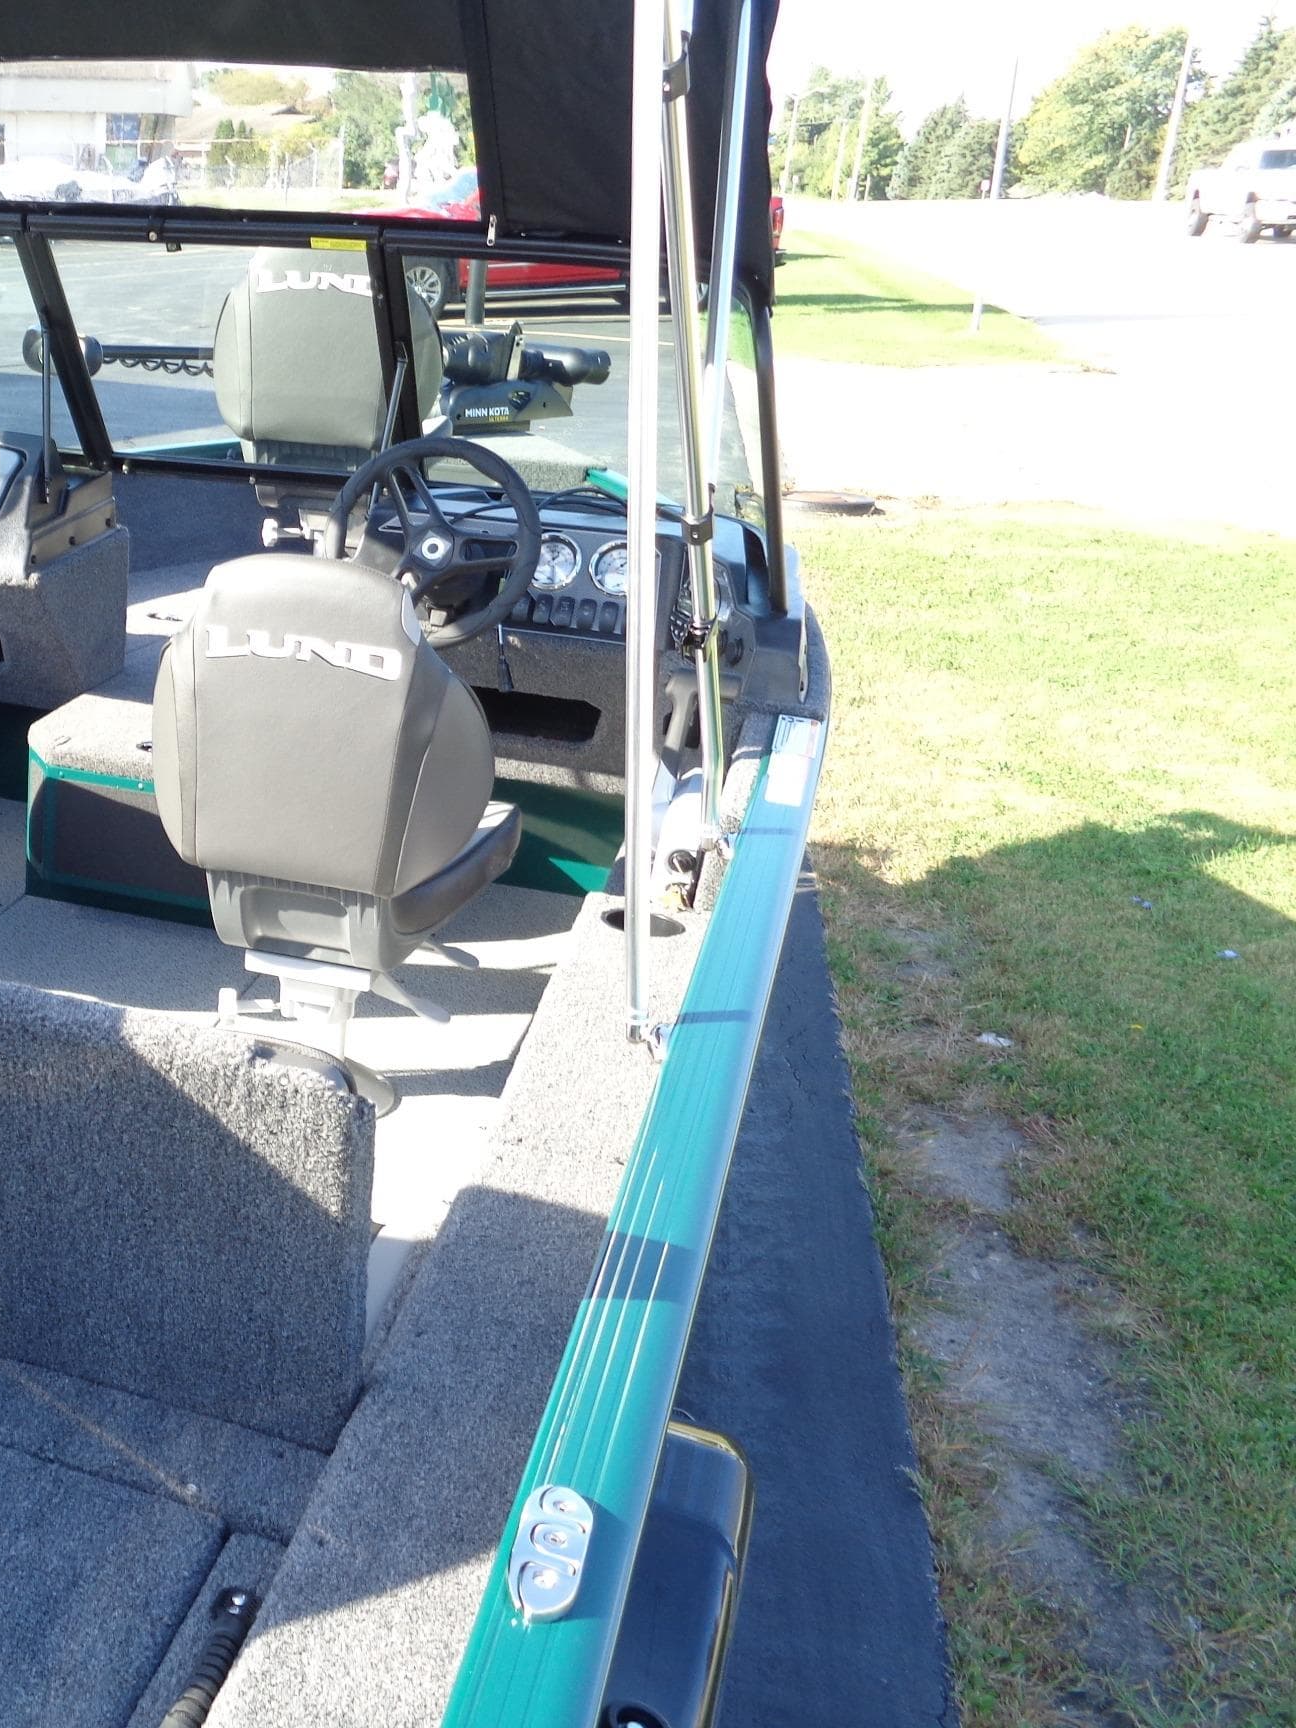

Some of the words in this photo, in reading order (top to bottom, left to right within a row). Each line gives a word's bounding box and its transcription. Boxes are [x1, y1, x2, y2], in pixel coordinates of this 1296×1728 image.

[465, 407, 488, 418] MINN
[489, 406, 510, 416] KOTA
[205, 624, 403, 681] LUND
